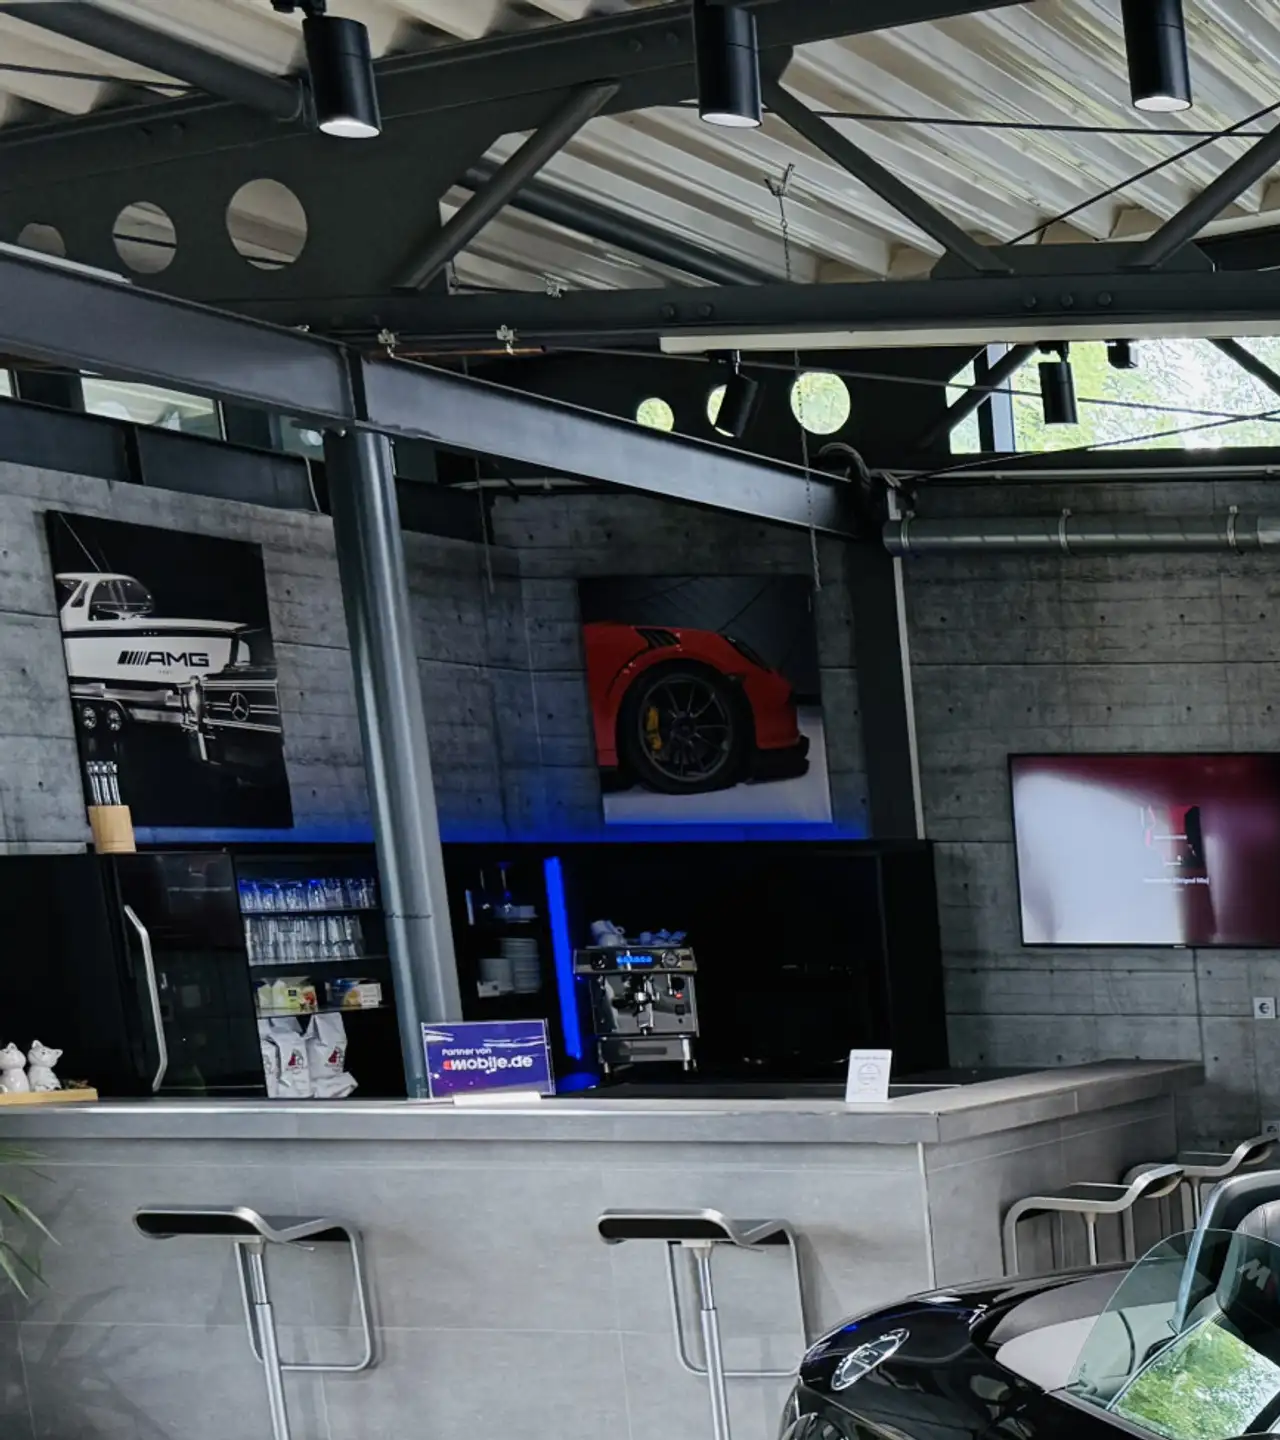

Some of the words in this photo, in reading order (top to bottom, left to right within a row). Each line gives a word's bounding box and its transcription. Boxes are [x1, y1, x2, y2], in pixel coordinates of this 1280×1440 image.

[144, 651, 210, 667] AMG
[441, 1047, 474, 1056] Partner
[475, 1046, 492, 1055] von
